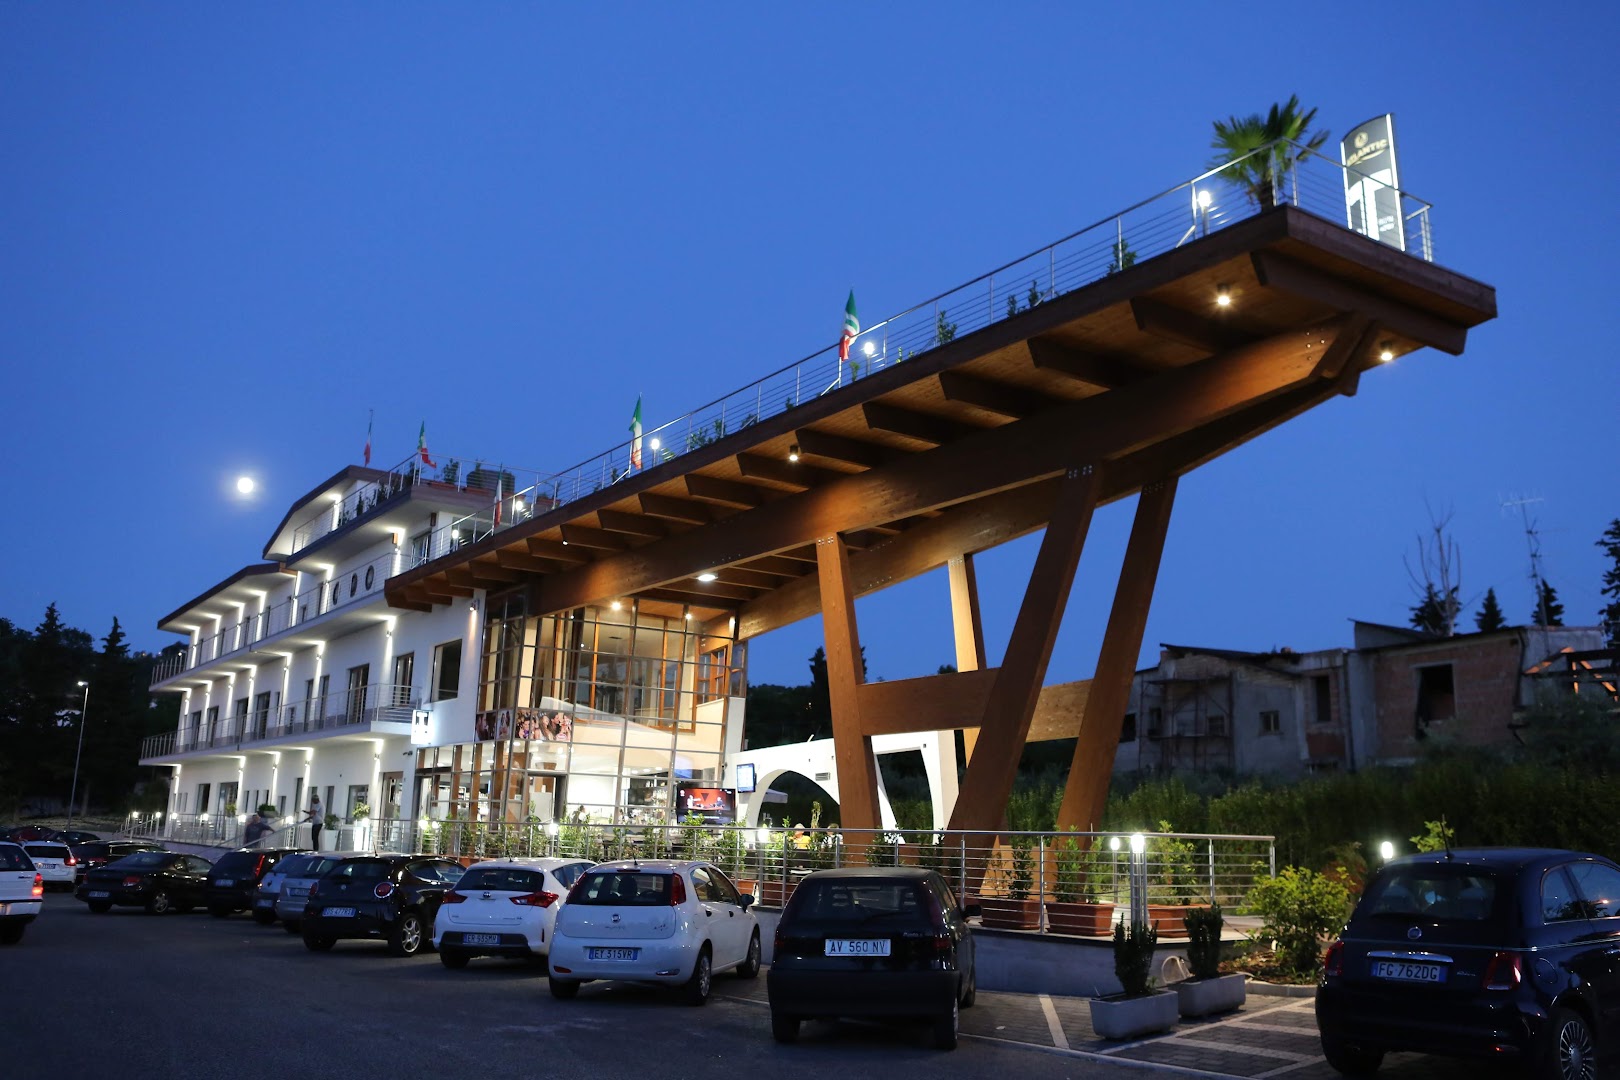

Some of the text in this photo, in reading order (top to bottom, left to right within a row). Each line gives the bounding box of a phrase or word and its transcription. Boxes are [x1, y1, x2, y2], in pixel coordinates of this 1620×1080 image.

[830, 941, 886, 954] AV 560 NV
[594, 949, 633, 960] EY 315VR
[1378, 962, 1394, 976] FG
[1397, 964, 1439, 981] 762DG
